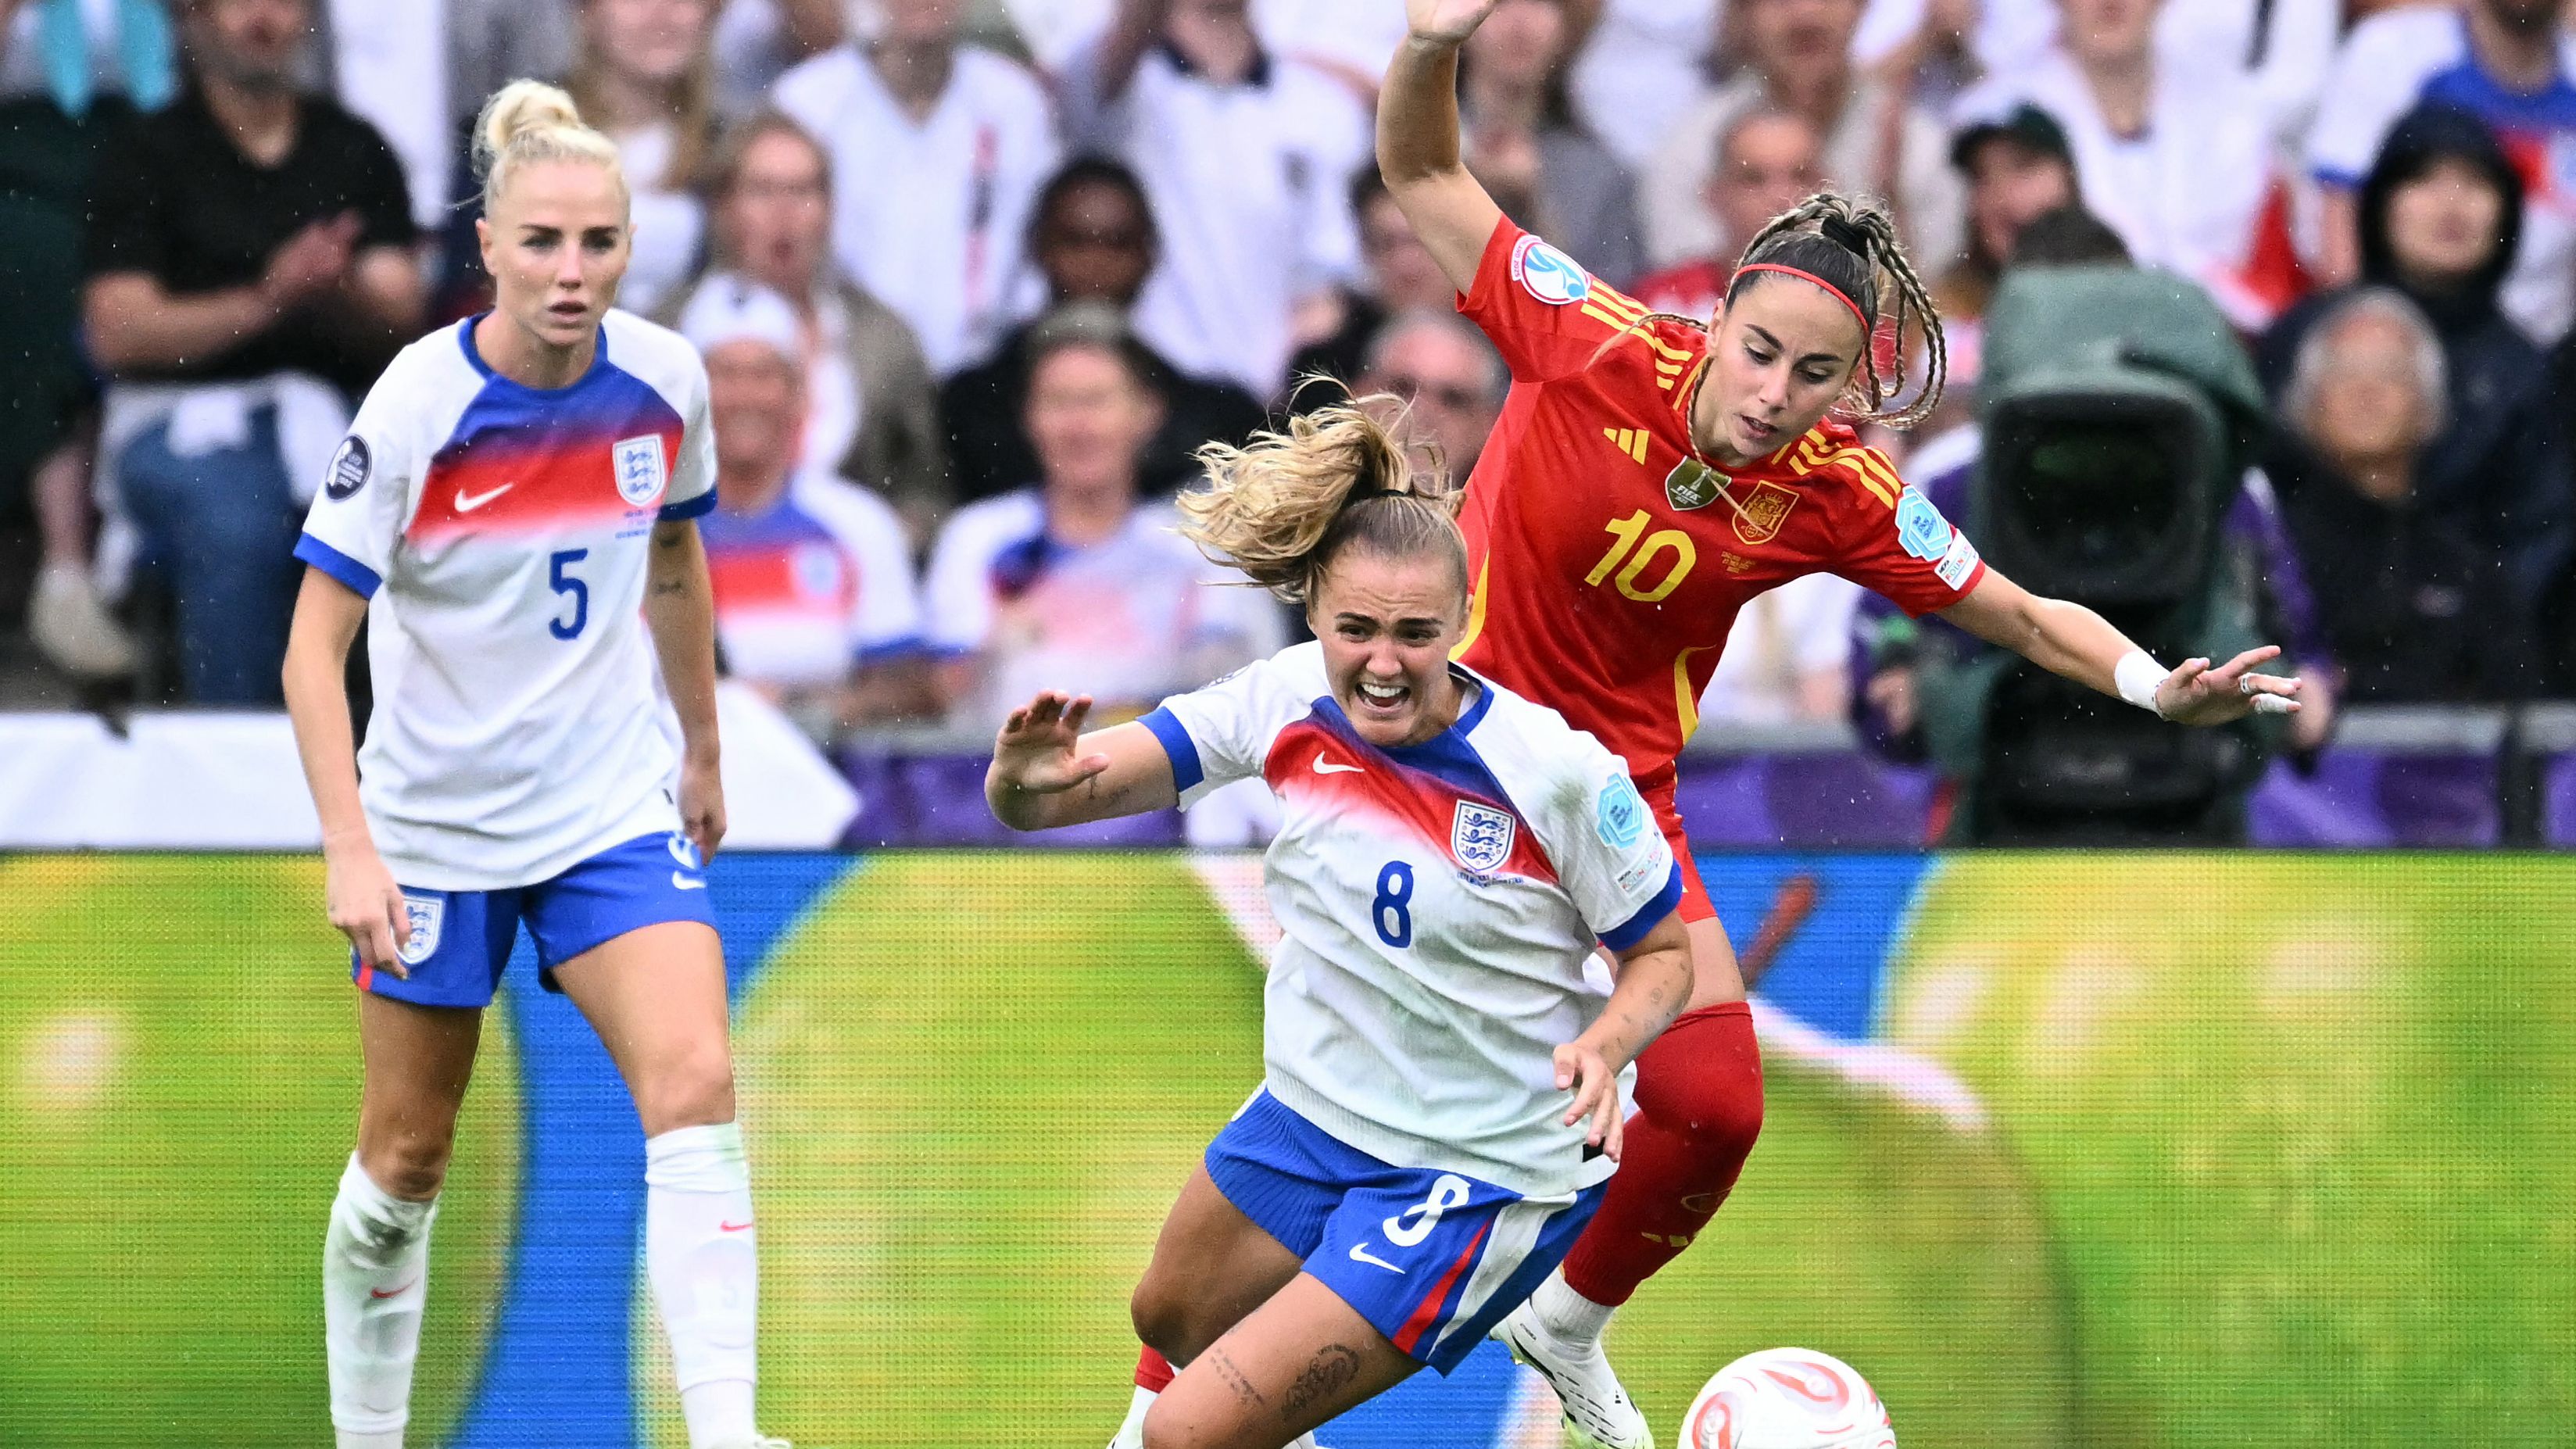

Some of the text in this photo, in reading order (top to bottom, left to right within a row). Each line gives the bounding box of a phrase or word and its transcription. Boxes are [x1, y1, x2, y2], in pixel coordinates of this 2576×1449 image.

[1676, 485, 1698, 501] FIFA
[549, 548, 588, 640] 5
[1583, 509, 1697, 602] 10
[1372, 860, 1413, 948] 8
[1383, 1174, 1472, 1247] 8
